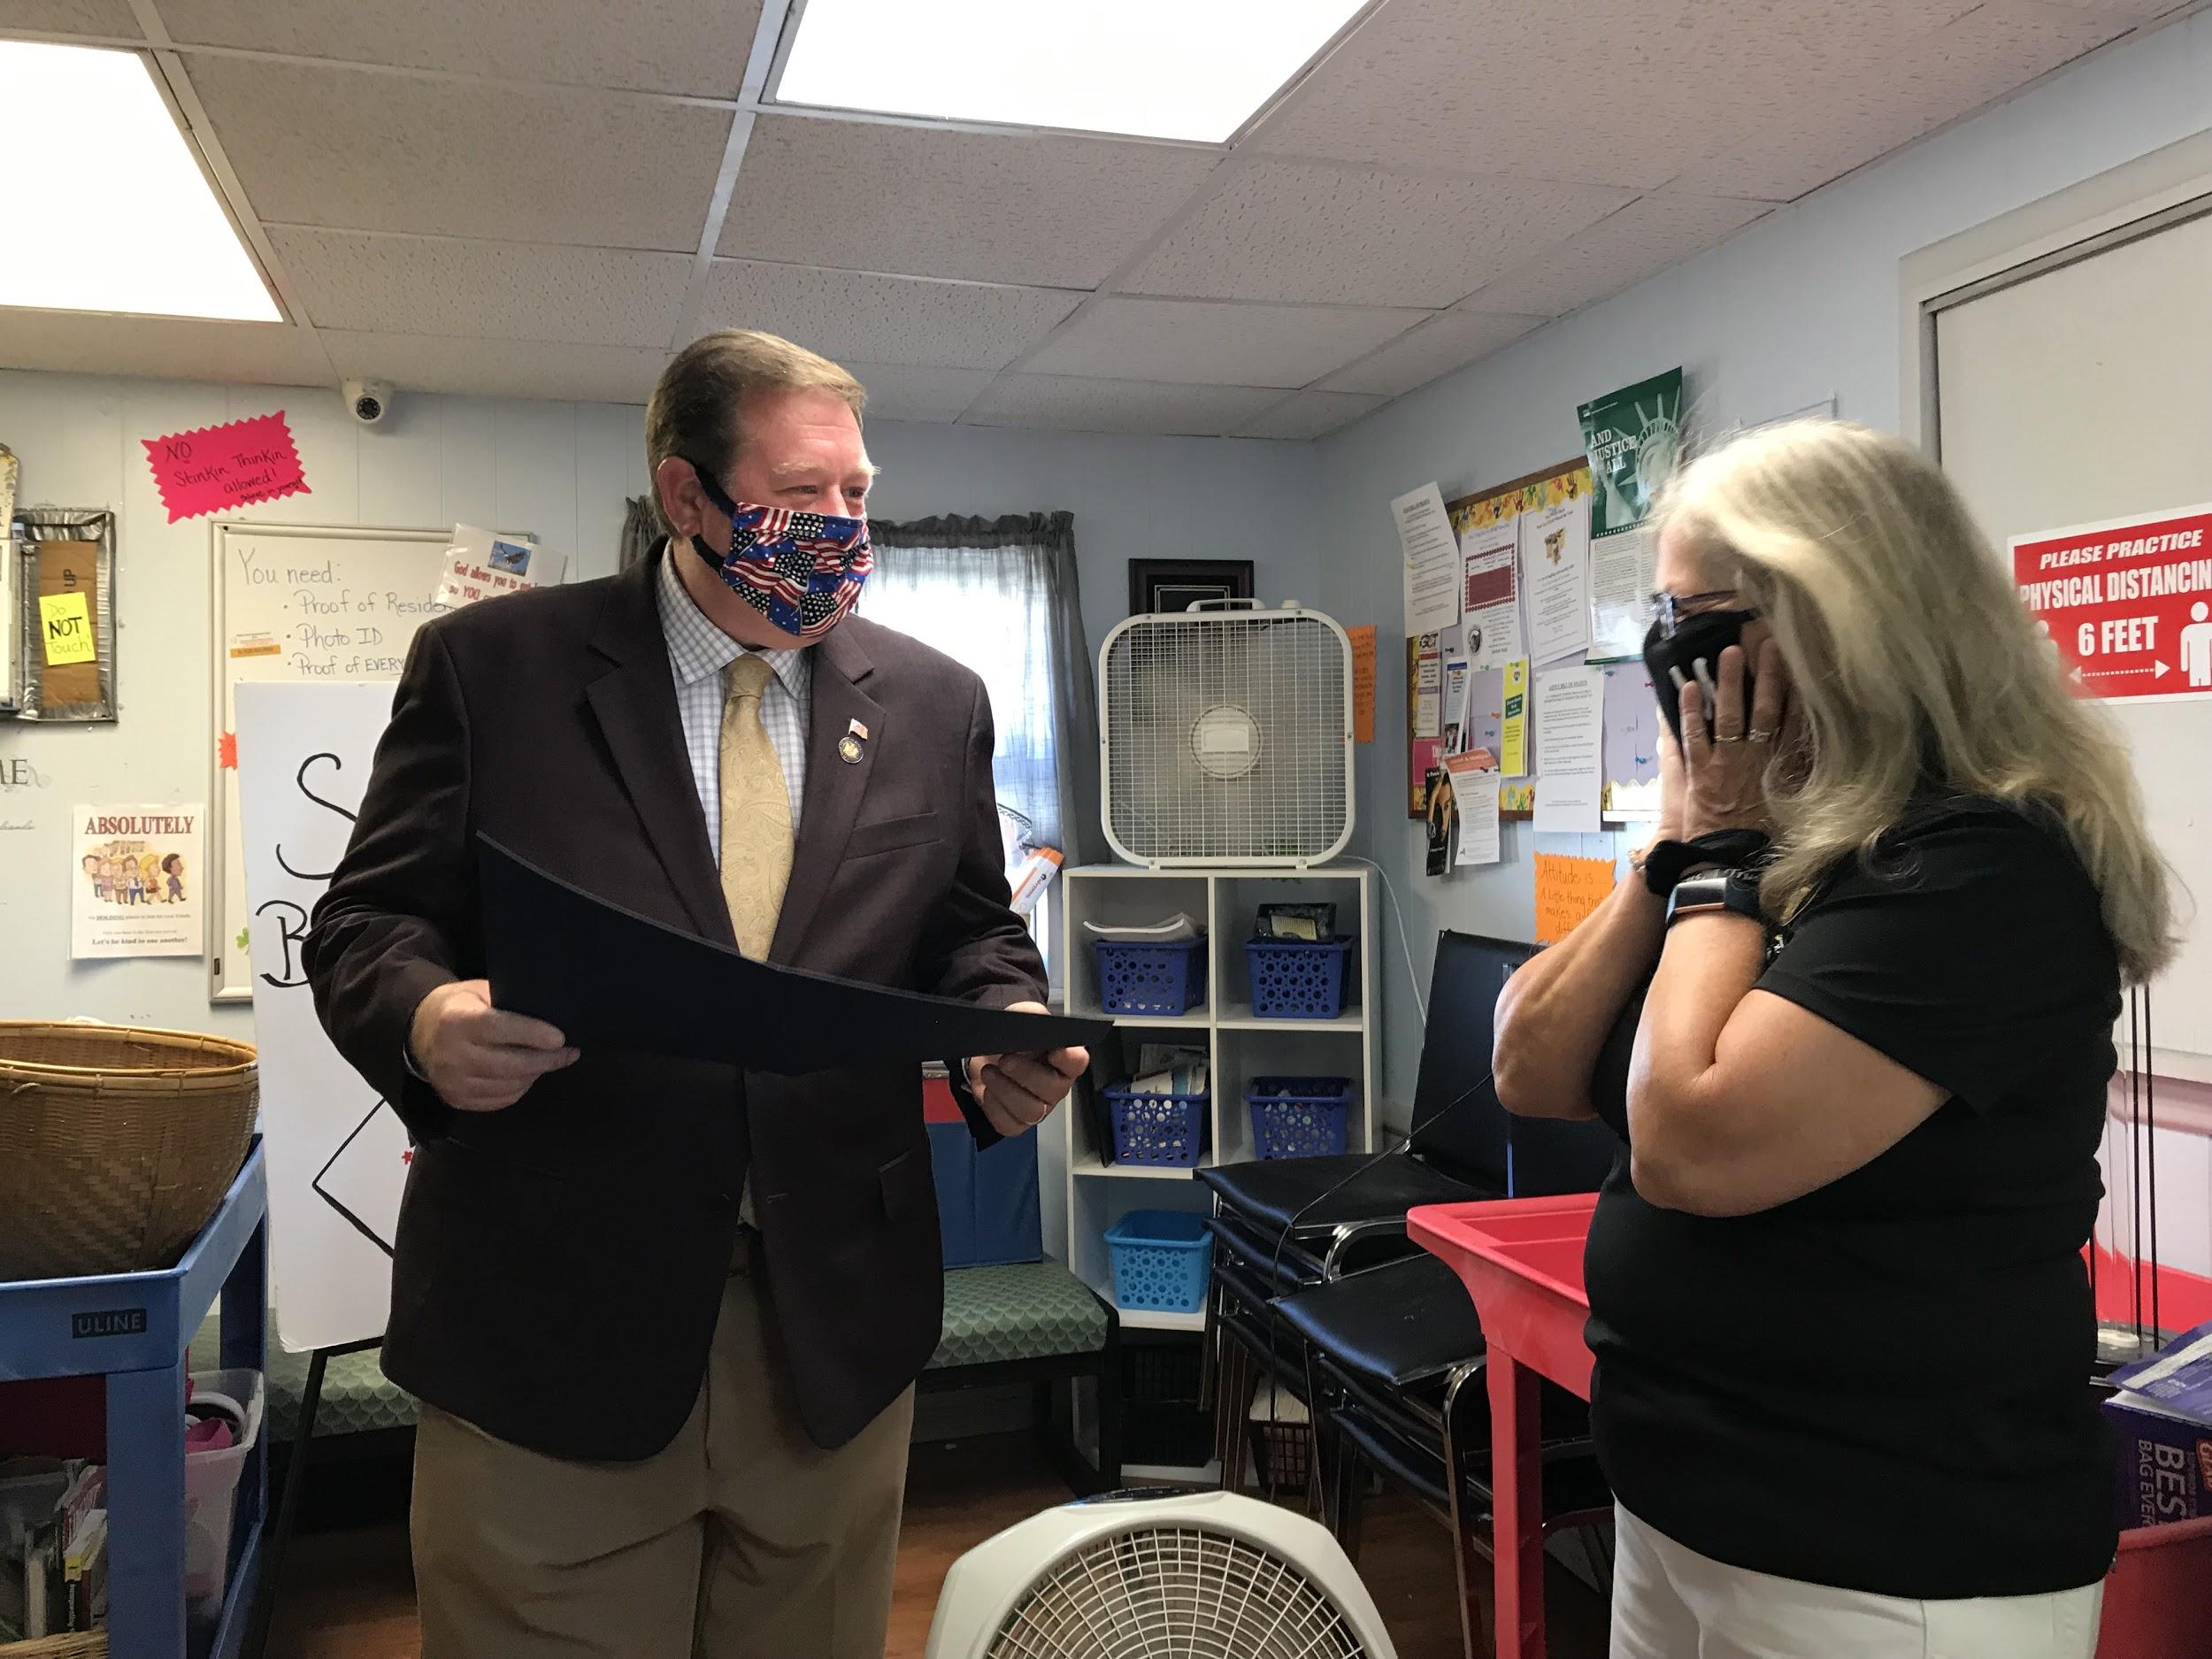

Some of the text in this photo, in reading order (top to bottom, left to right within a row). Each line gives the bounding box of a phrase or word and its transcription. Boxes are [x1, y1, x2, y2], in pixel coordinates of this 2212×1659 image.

[1590, 429, 1612, 449] AND
[1594, 434, 1638, 463] JUSTICE
[165, 441, 192, 463] NO
[1606, 457, 1626, 474] ALL
[2039, 529, 2204, 571] PLEASE PRACTICE
[63, 568, 78, 587] UP
[238, 547, 342, 586] You need:
[454, 561, 469, 577] God
[470, 565, 492, 582] allows
[510, 578, 518, 590] to
[464, 585, 481, 601] YOU
[2019, 557, 2212, 611] PHYSICAL DISTANCIN
[47, 603, 67, 617] Do
[293, 588, 351, 615] Proof
[357, 592, 378, 612] of
[48, 617, 83, 640] NOT
[296, 622, 351, 651] Photo
[355, 626, 383, 646] ID
[2078, 615, 2160, 657] 6 FEET
[45, 634, 93, 655] Touch
[292, 651, 339, 676] Proof
[345, 656, 361, 673] of
[85, 816, 195, 835] ABSOLUTELY
[1541, 860, 1582, 886] Attitude
[1555, 919, 1573, 935] diff
[77, 1312, 142, 1335] ULINE
[2138, 1439, 2157, 1527] BAG EVER
[2154, 1442, 2189, 1524] BES
